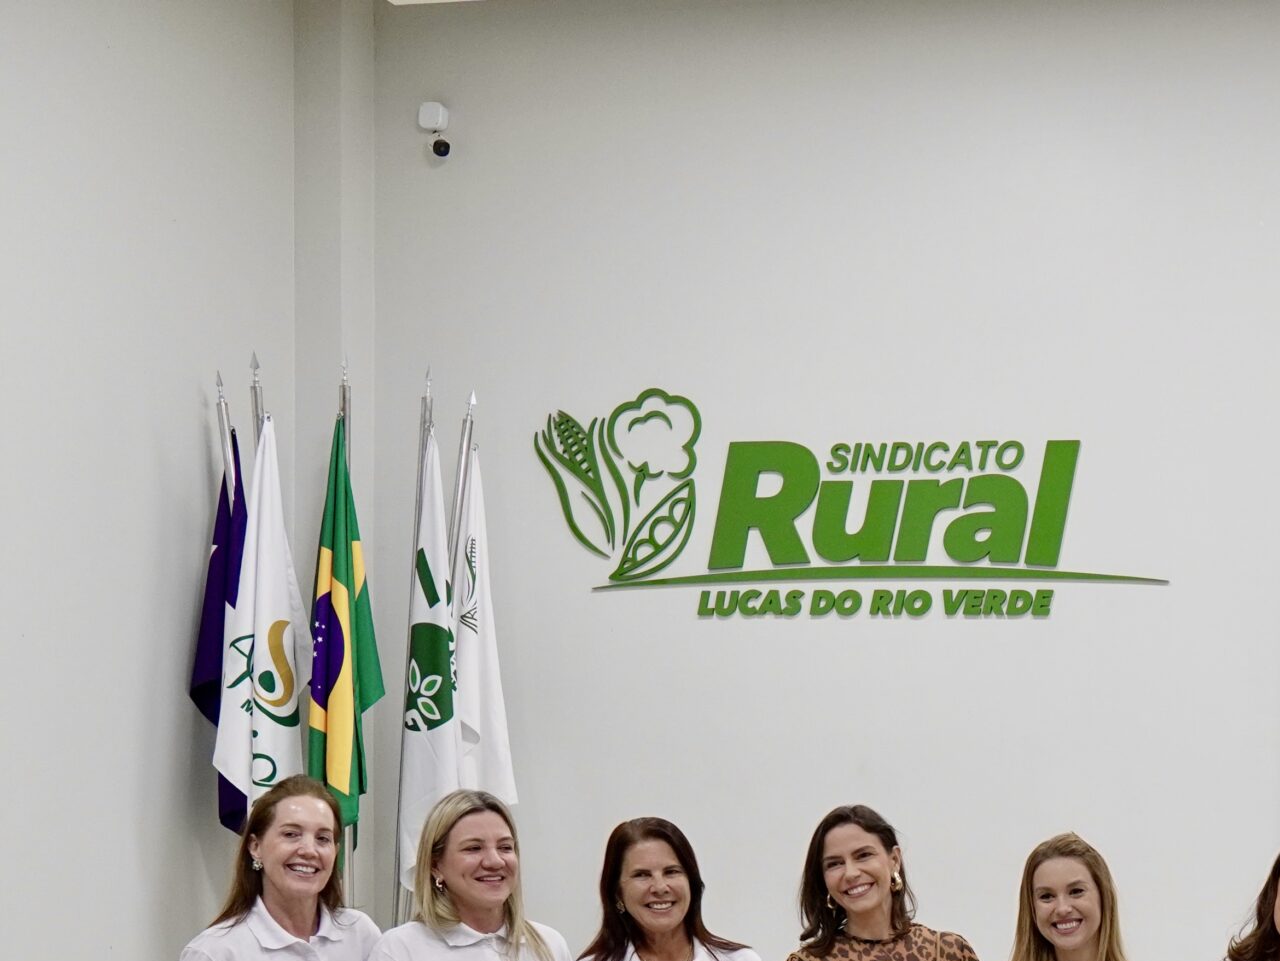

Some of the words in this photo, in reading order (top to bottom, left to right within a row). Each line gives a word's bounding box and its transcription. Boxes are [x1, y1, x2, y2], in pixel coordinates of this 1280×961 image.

[826, 440, 1025, 473] SINDICATO
[707, 440, 1081, 570] Rural
[697, 589, 805, 617] LUCAS
[810, 589, 863, 617] DO
[869, 589, 933, 617] RIO
[942, 589, 1054, 617] VERDE
